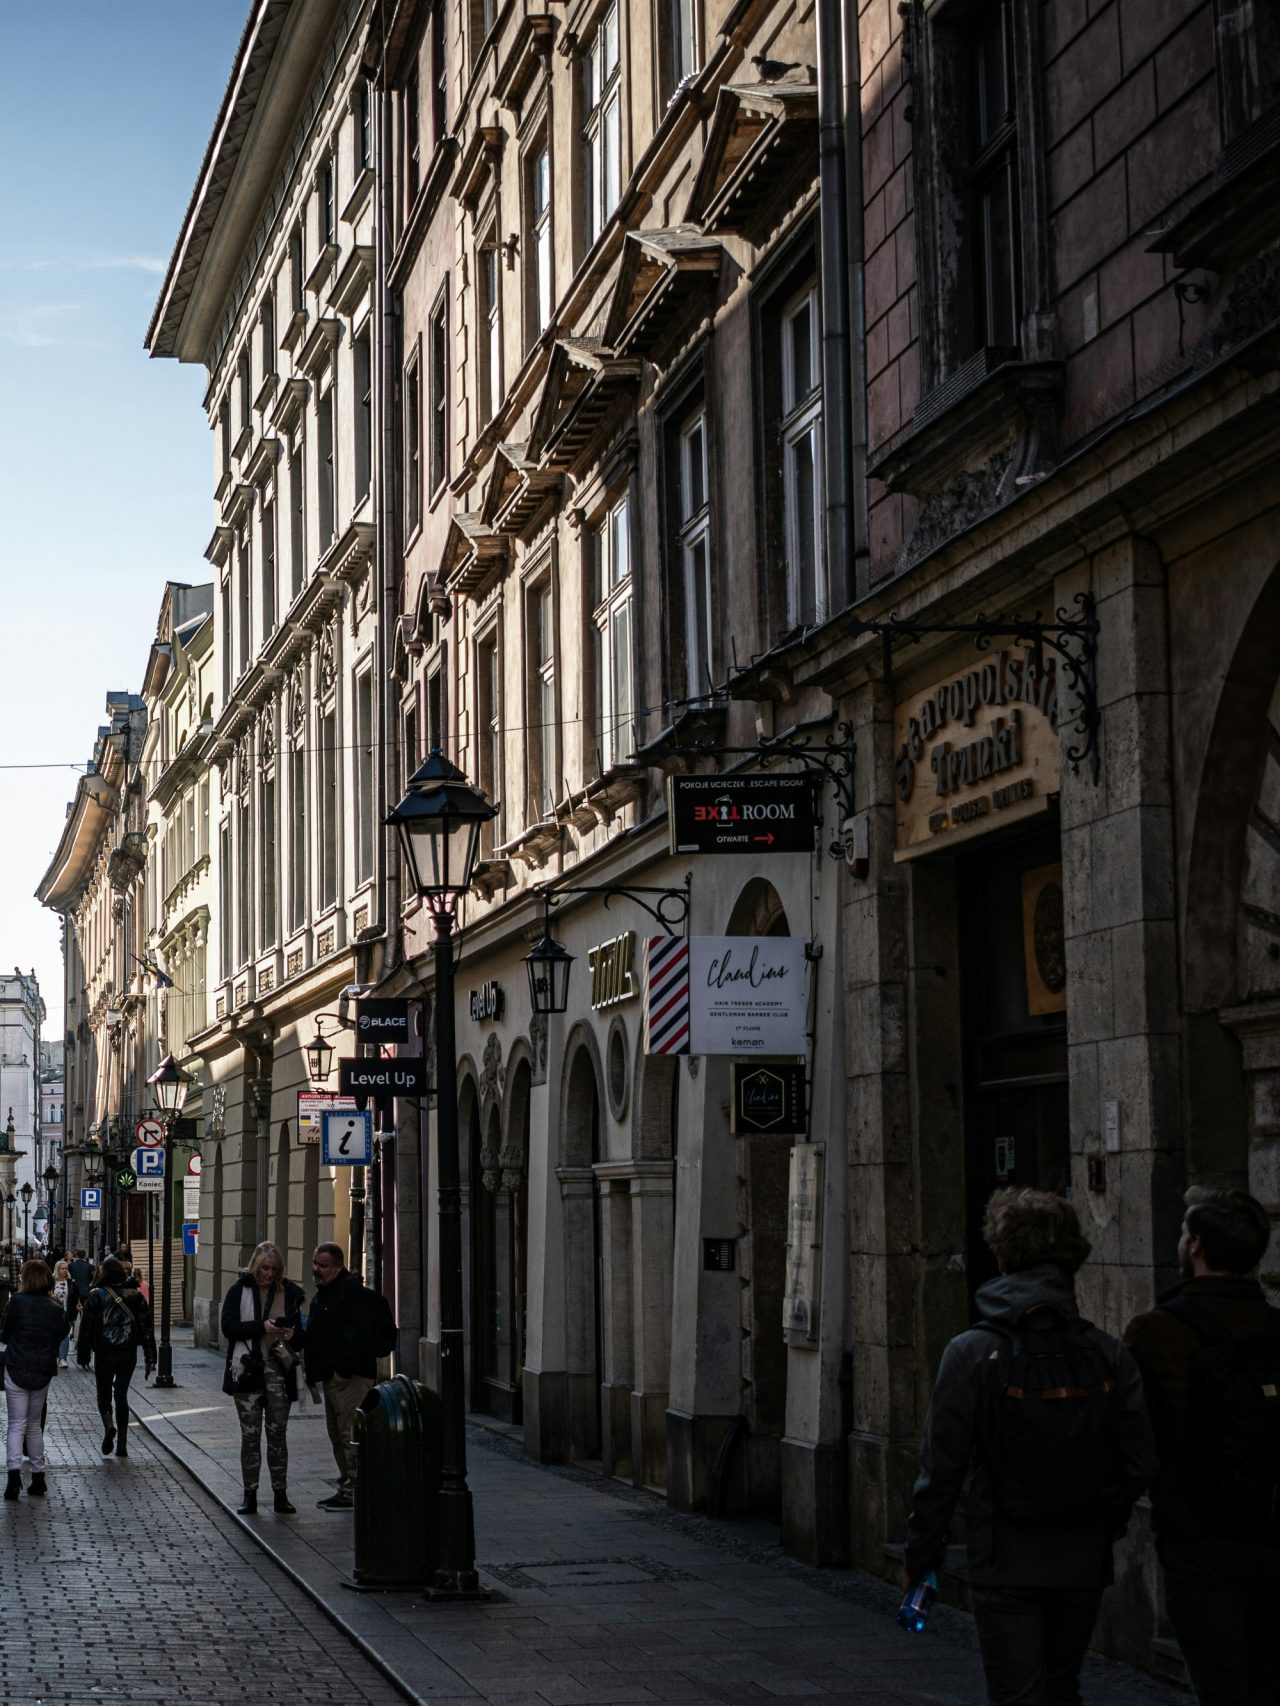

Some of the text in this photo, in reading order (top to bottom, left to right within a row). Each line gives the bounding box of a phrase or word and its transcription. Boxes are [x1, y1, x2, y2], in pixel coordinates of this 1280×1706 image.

[932, 709, 1025, 796] Trunki
[680, 781, 709, 789] POKOJE
[710, 780, 745, 789] UCIECZEK
[742, 804, 796, 820] ROOM
[716, 834, 749, 843] OTWARTE
[707, 944, 790, 989] Claudius
[350, 1072, 416, 1088] Level Up
[142, 1151, 159, 1174] P
[85, 1190, 97, 1207] P
